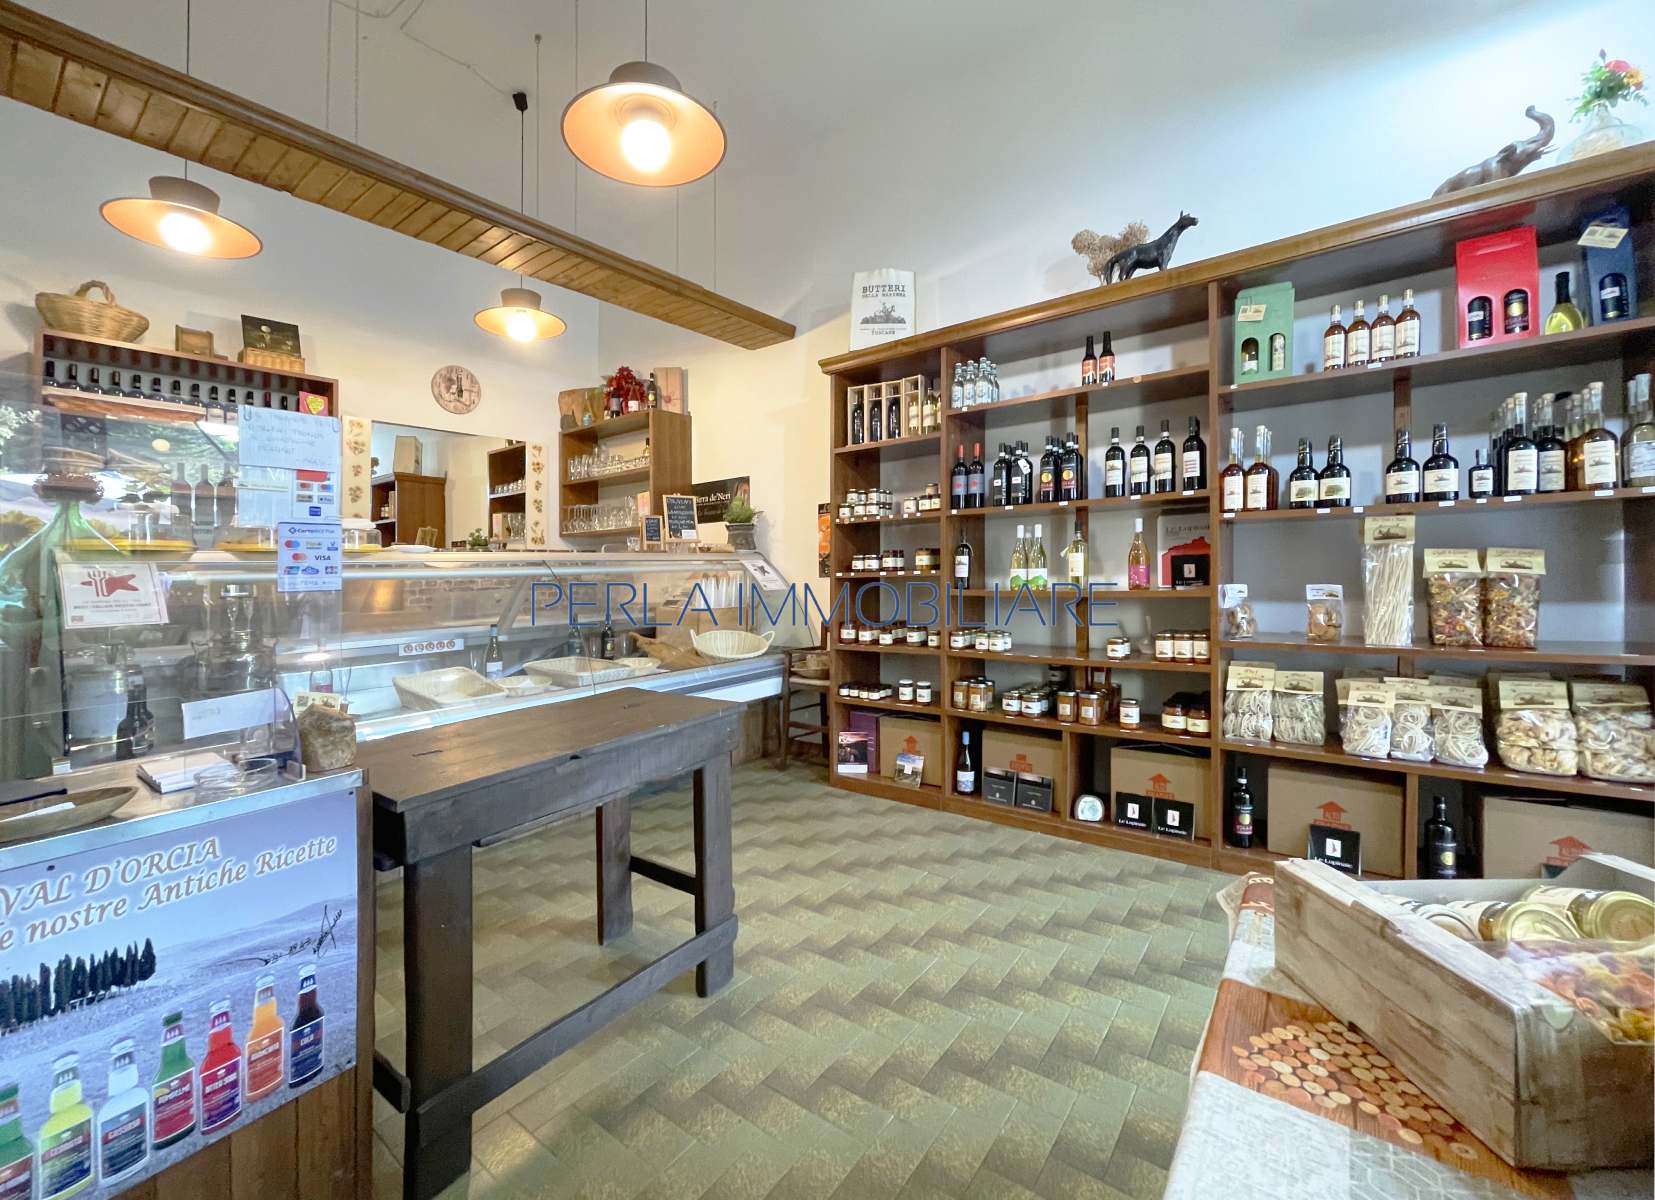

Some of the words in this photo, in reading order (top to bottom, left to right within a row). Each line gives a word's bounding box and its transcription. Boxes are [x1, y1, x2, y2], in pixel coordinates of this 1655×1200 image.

[862, 284, 906, 293] BUTTERI
[0, 874, 73, 916] VAL
[83, 837, 221, 895] D'ORCIA
[0, 914, 14, 951] e
[26, 897, 128, 943] nostre
[137, 858, 248, 911] Antiche
[255, 836, 337, 878] Ricette
